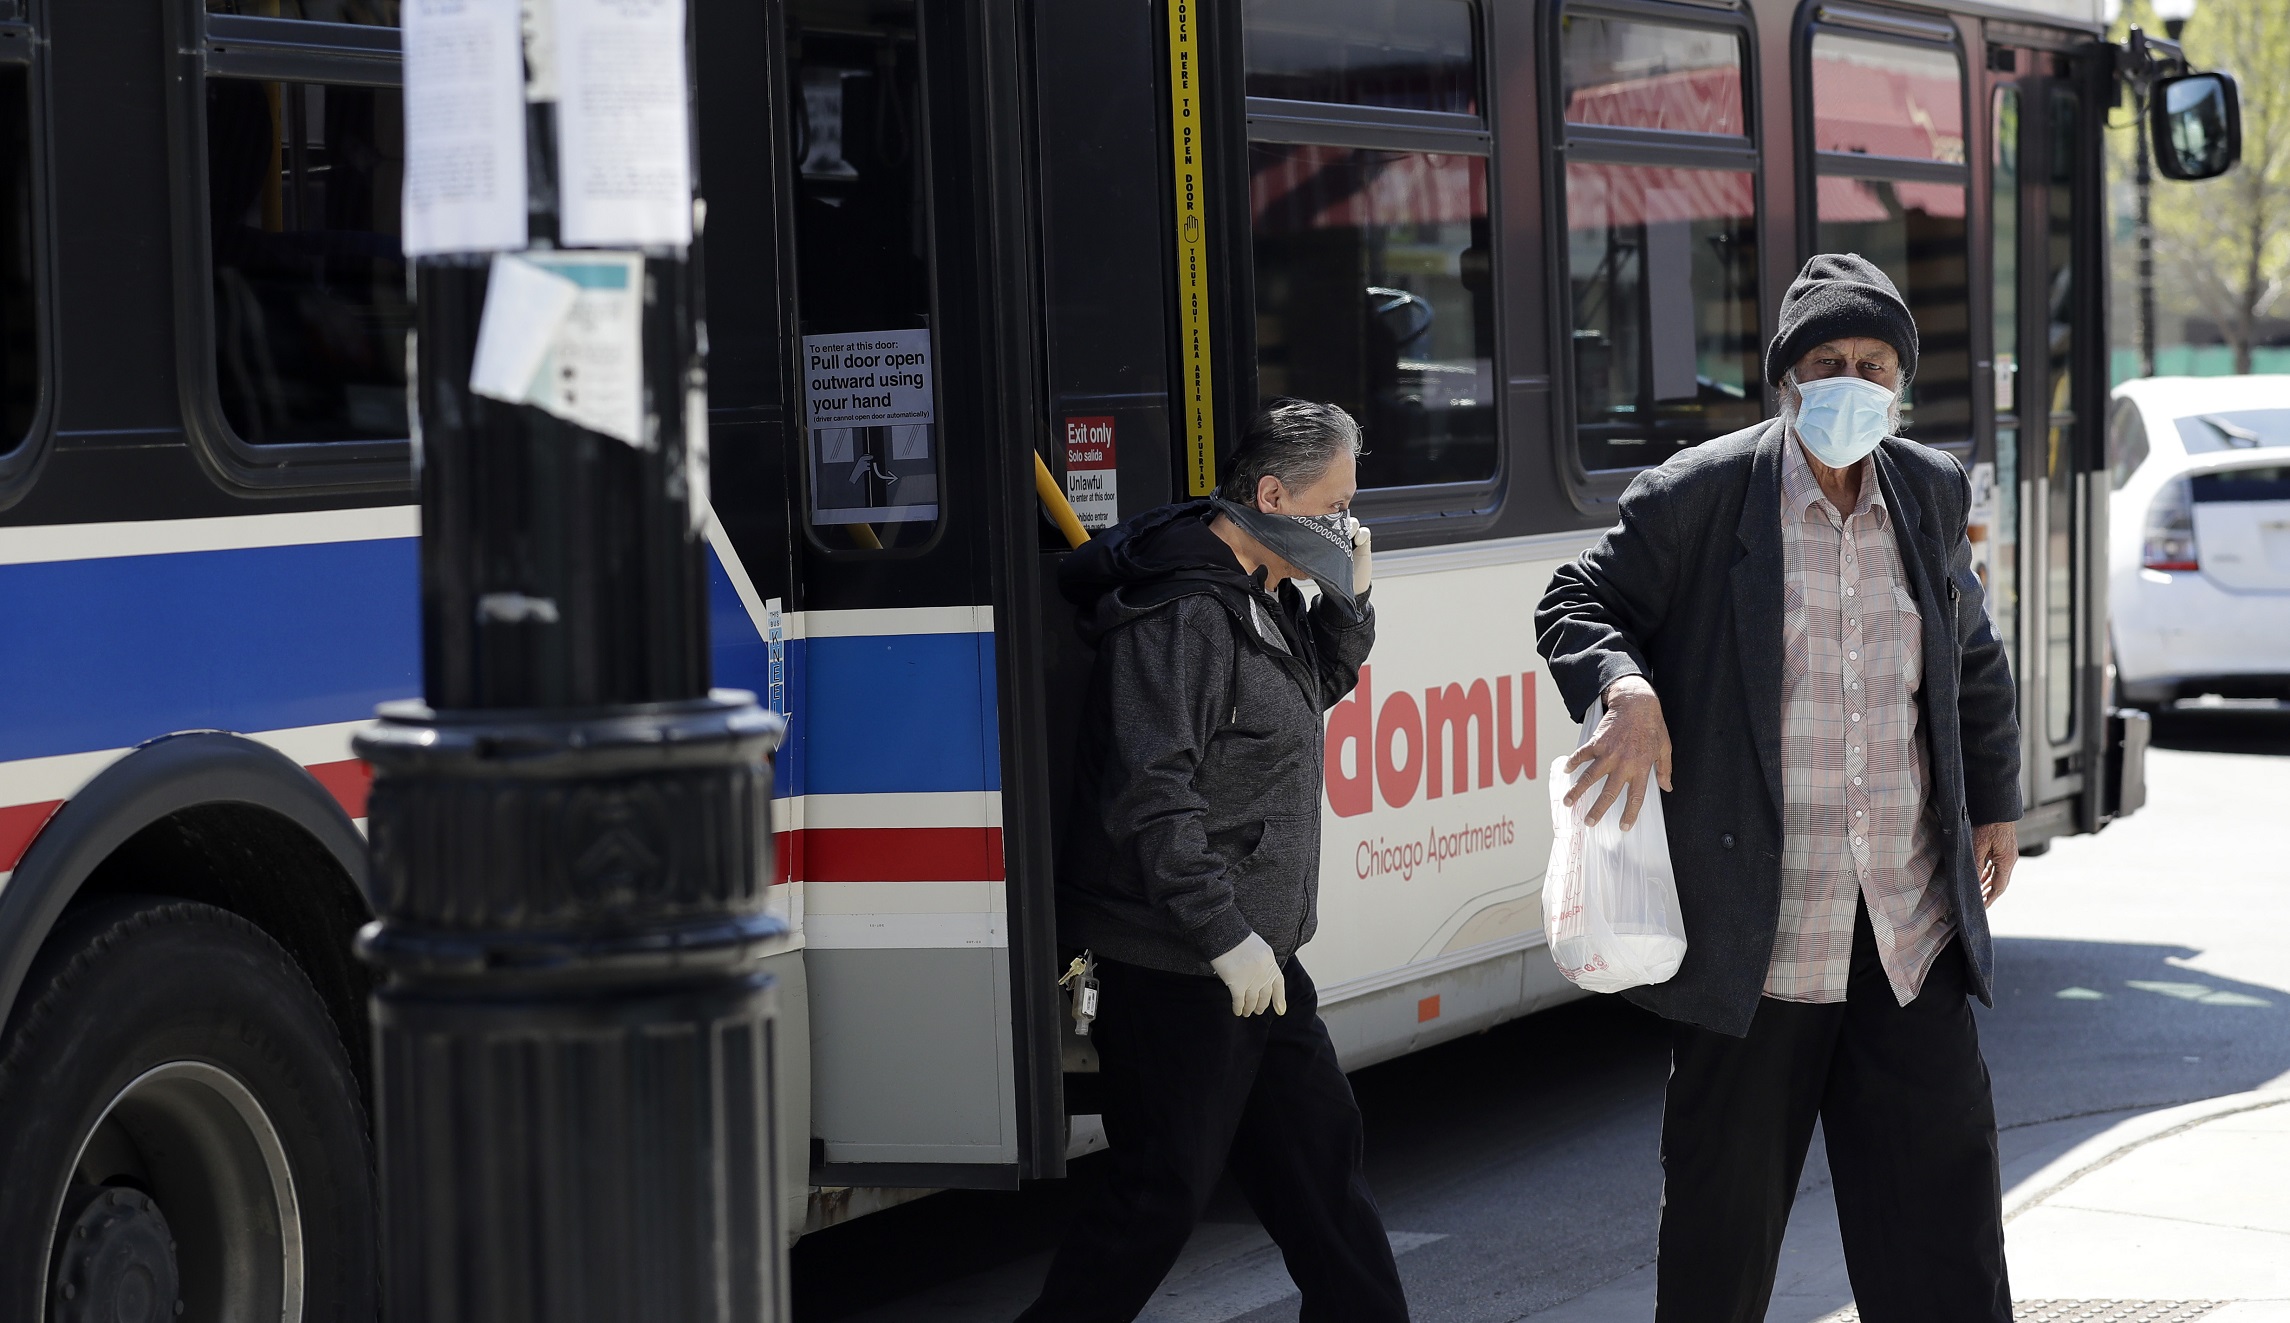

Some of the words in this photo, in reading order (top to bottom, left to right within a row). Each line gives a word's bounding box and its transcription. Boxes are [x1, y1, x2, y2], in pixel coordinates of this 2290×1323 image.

[1181, 52, 1189, 89] HERE
[1183, 99, 1191, 117] TO
[1184, 127, 1192, 164] OPEN
[1186, 174, 1194, 210] DOOR
[809, 344, 820, 353] To
[822, 344, 844, 352] enter
[846, 342, 855, 351] at
[857, 341, 873, 350] this
[875, 341, 898, 350] door:
[811, 355, 840, 370] Pull
[844, 354, 880, 369] door
[884, 352, 924, 369] open
[812, 373, 874, 391] outward
[879, 371, 924, 389] using
[1194, 365, 1202, 401] ABRIR
[812, 397, 848, 414] your
[852, 392, 891, 409] hand
[814, 415, 832, 424] (driver
[833, 414, 854, 422] cannot
[855, 414, 870, 422] open
[886, 410, 930, 419] automatically)
[1067, 423, 1088, 444] Exit
[1090, 422, 1112, 448] only
[1068, 449, 1083, 462] Solo
[1084, 449, 1103, 462] salida
[1197, 435, 1205, 488] PUERTAS
[1069, 474, 1103, 491] Unlawful
[1070, 495, 1075, 503] to
[1076, 494, 1088, 502] enter
[1089, 493, 1094, 501] at
[1095, 492, 1103, 501] this
[1104, 492, 1115, 501] door
[1077, 512, 1093, 522] hibido
[1095, 513, 1110, 521] entrar
[1324, 664, 1538, 819] domu
[1356, 836, 1424, 882] Chicago
[1427, 814, 1514, 872] Apartments
